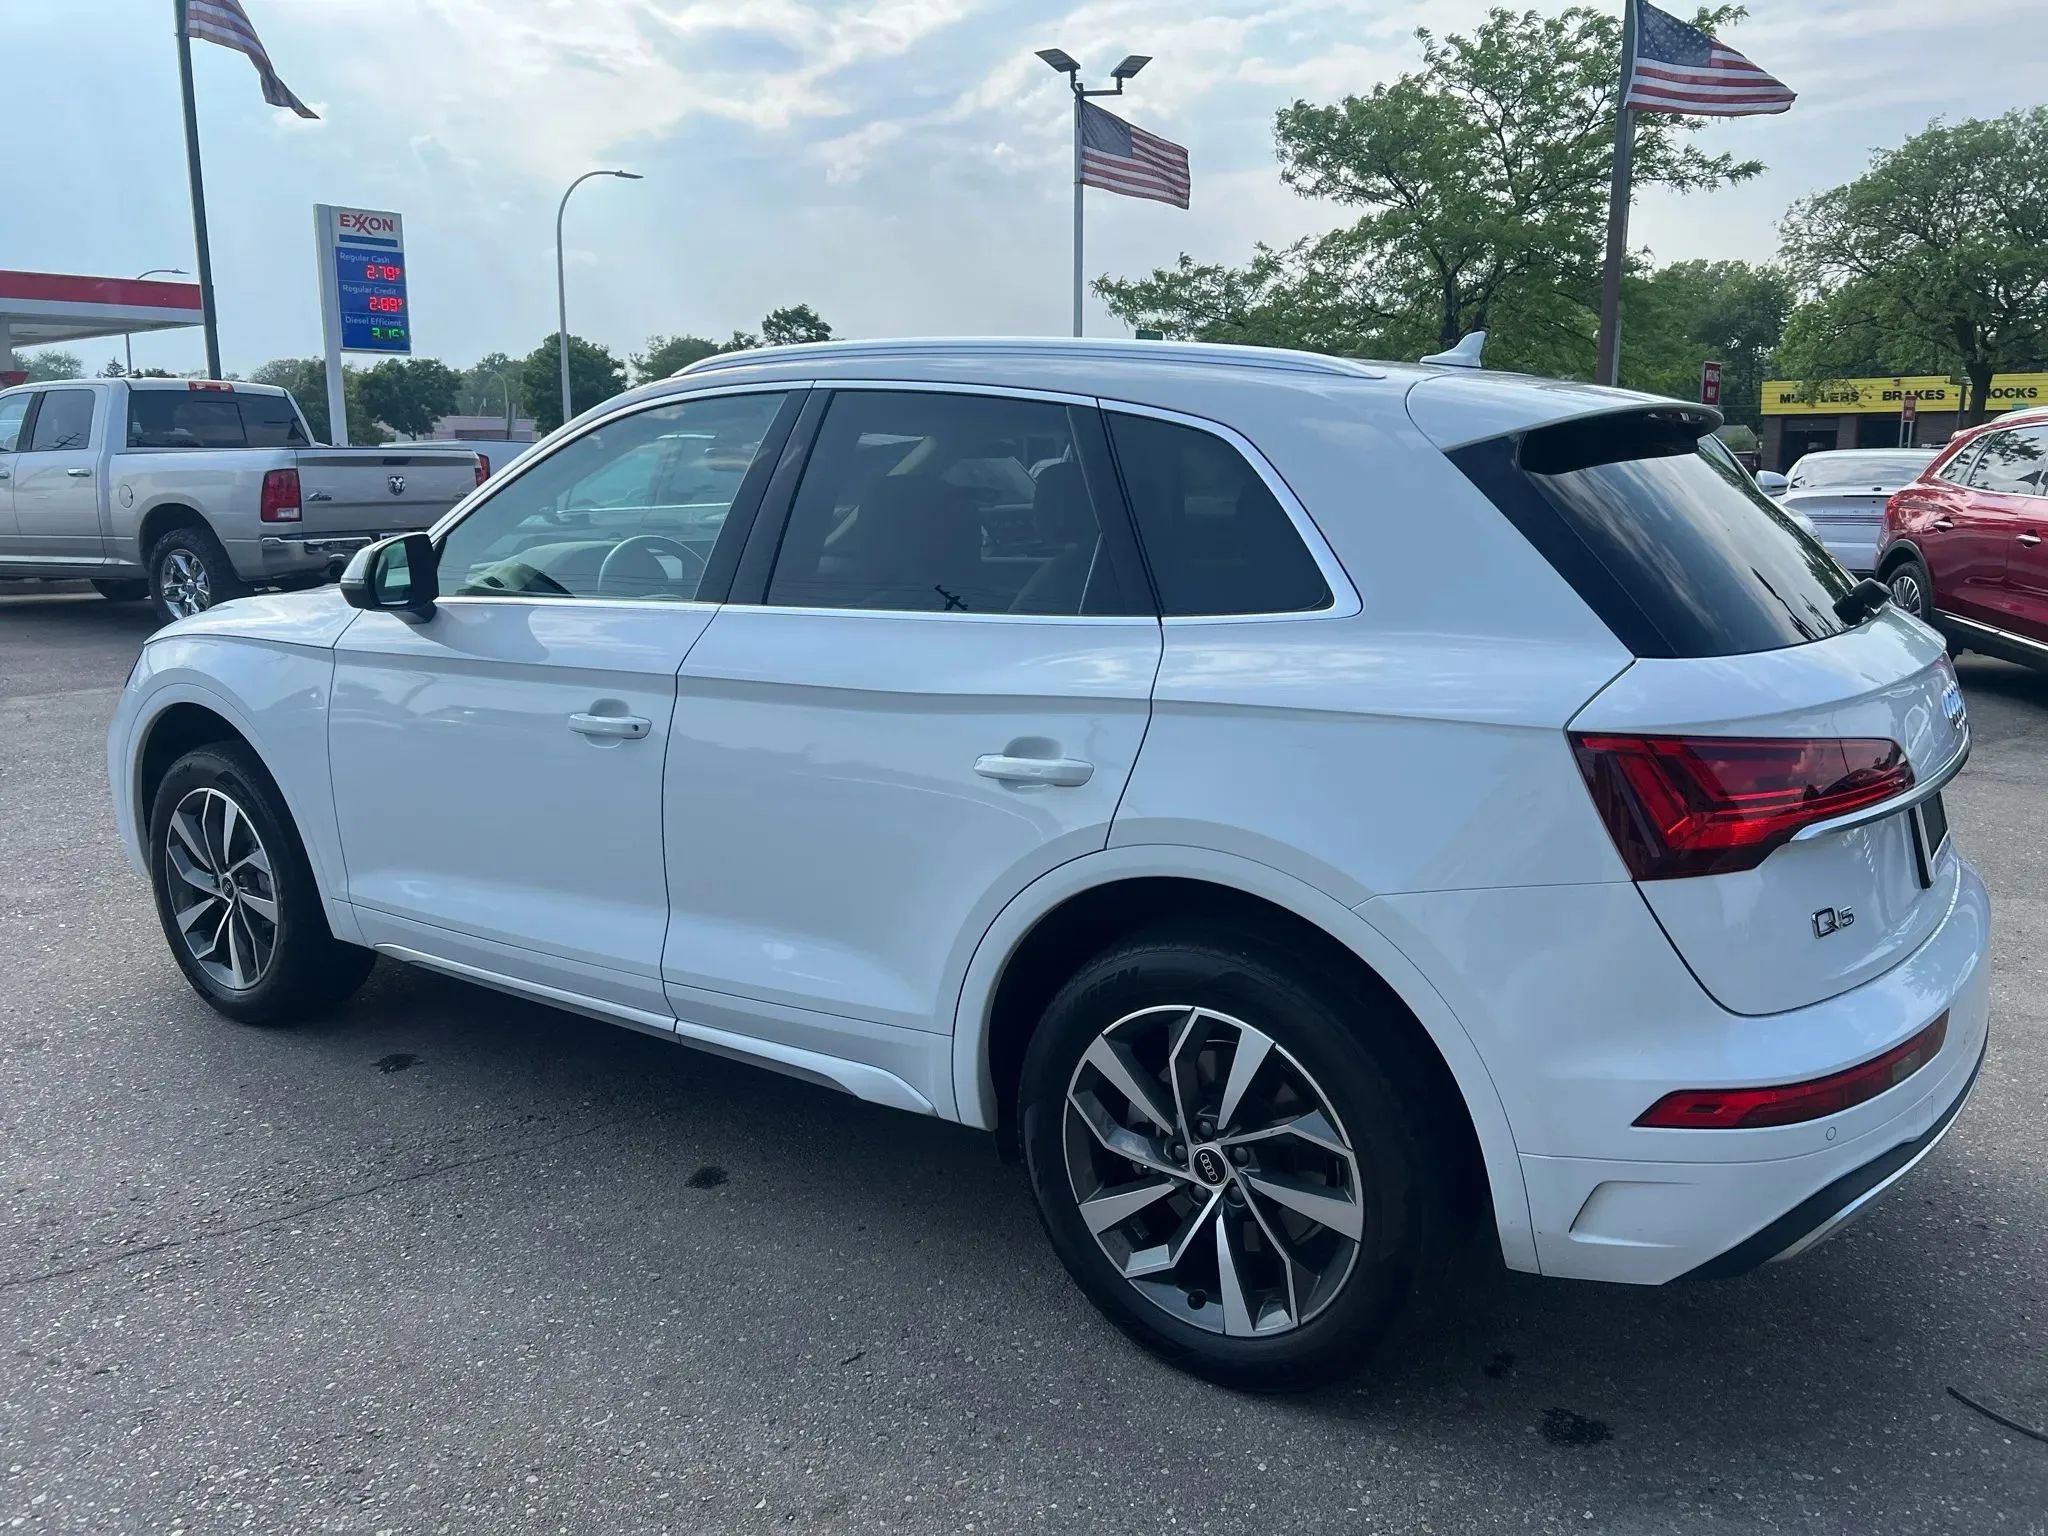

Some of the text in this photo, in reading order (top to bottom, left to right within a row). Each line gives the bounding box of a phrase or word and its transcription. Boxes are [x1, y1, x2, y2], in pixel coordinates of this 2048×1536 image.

[340, 213, 393, 235] EXXON
[340, 252, 390, 263] Regular Cash
[342, 284, 396, 295] Regular Credit
[345, 316, 402, 326] Diesel Efficient
[1986, 387, 2038, 399] OCKS
[1811, 906, 1855, 939] Q5
